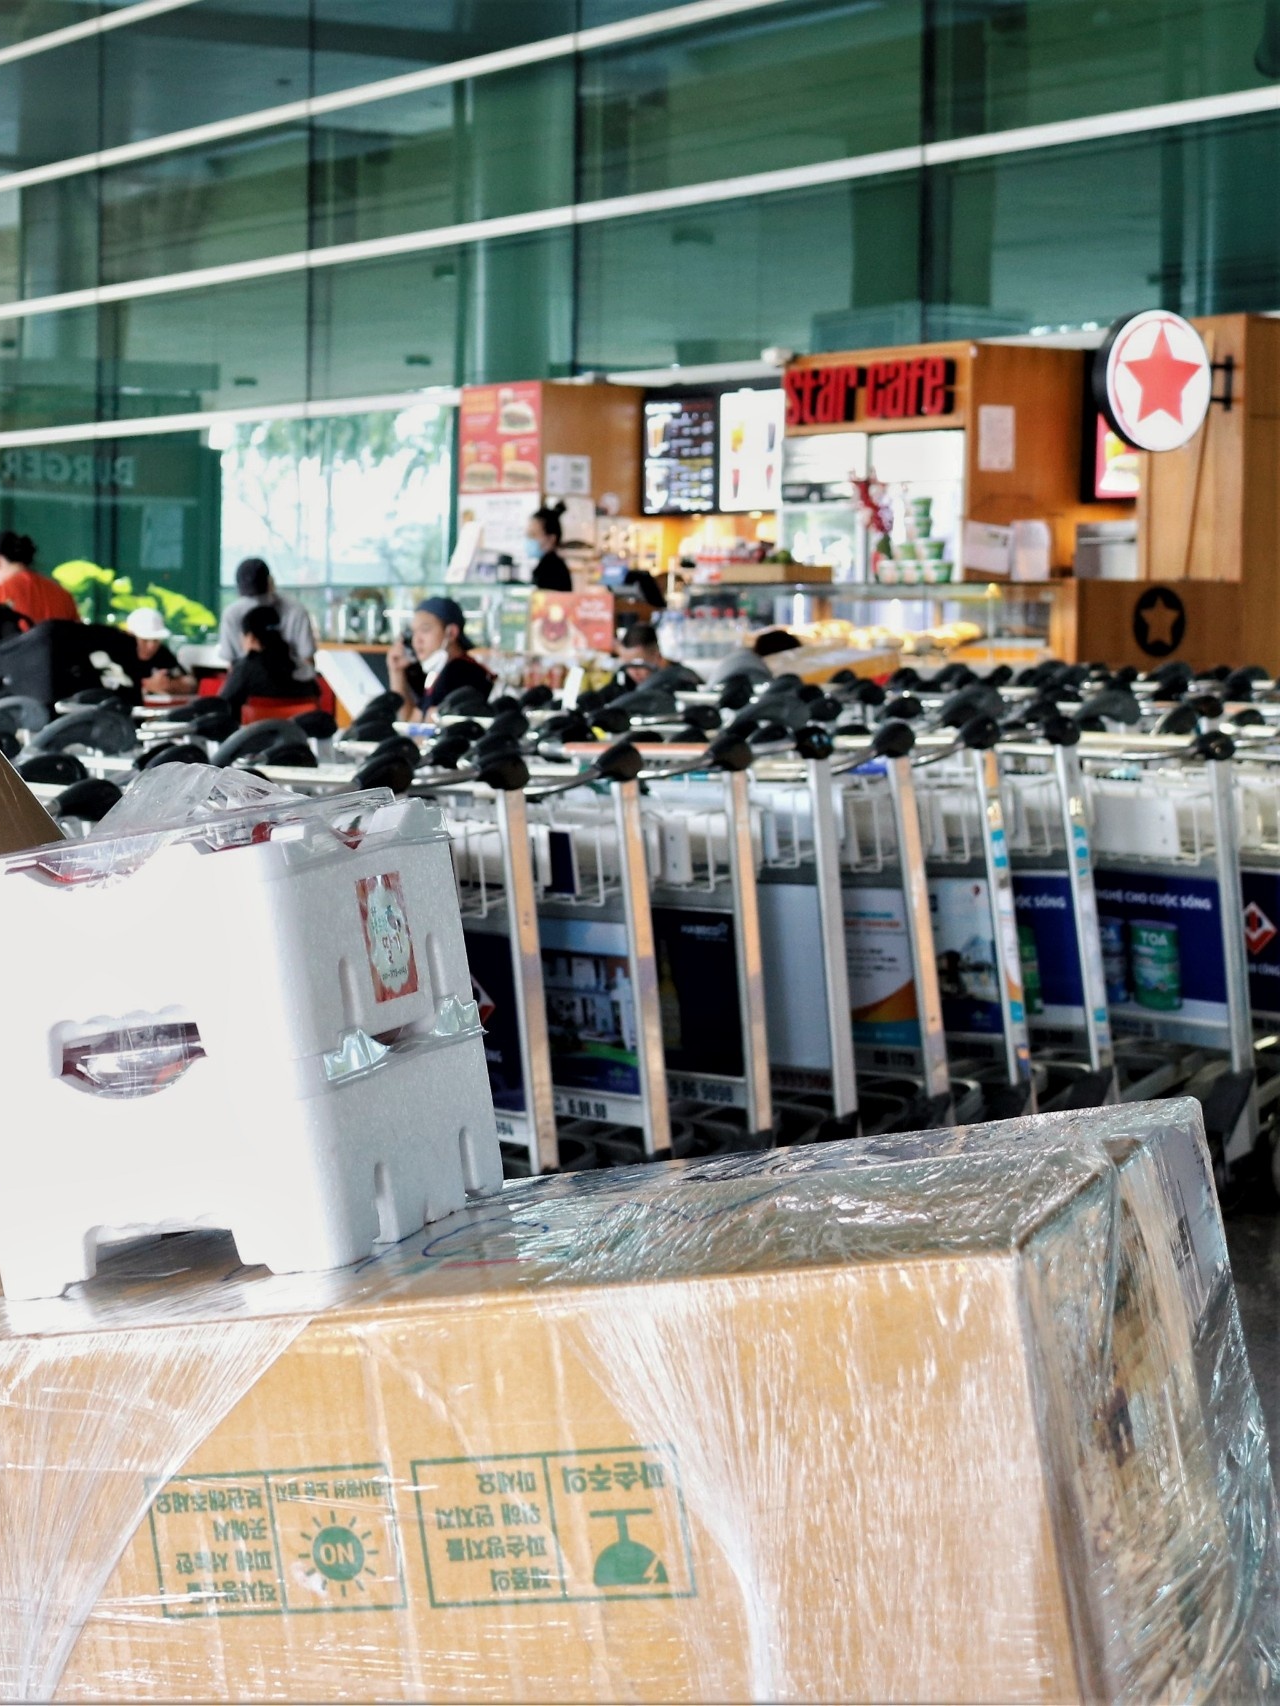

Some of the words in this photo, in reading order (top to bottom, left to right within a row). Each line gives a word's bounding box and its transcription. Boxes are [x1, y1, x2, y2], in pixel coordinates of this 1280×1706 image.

[1140, 930, 1169, 947] TOA
[476, 1470, 536, 1495] 마세요
[562, 1461, 664, 1495] 파손주의
[319, 1541, 356, 1565] NO
[446, 1535, 547, 1562] 파손방지를
